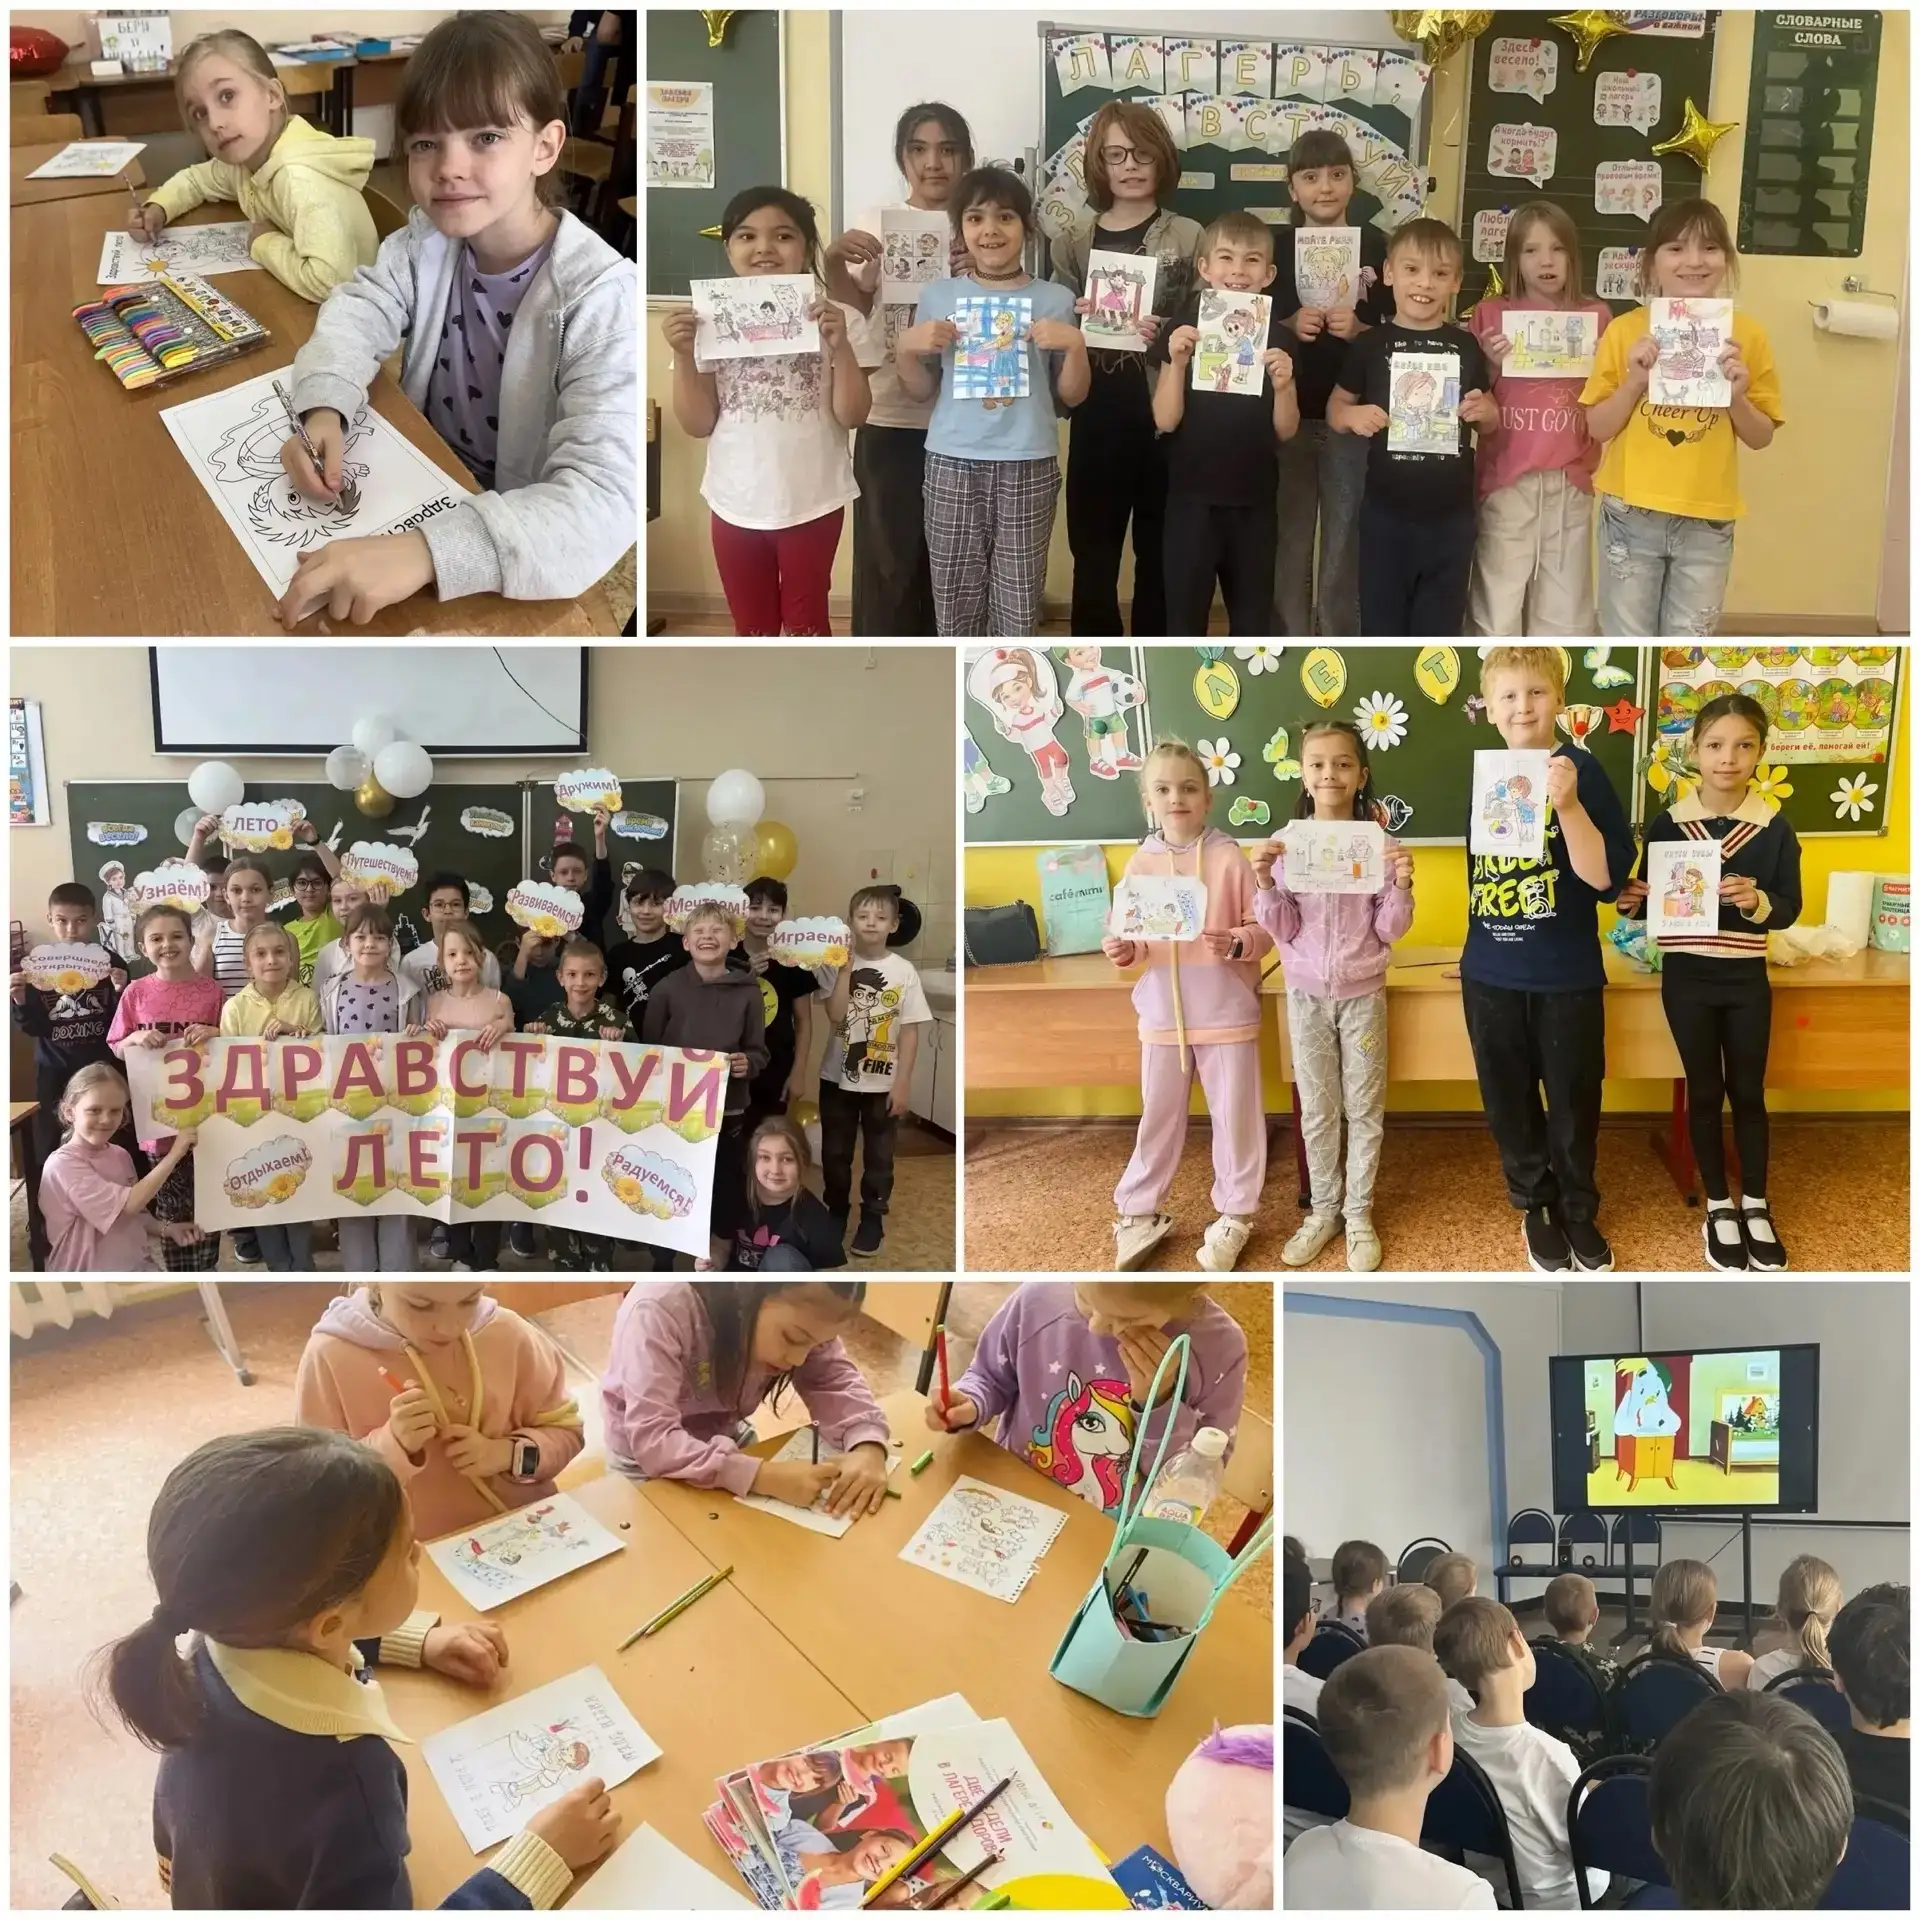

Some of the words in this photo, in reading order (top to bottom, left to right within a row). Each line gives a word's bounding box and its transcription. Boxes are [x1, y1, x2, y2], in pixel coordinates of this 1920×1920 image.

[1775, 14, 1863, 29] СЛОВАРНЫЕ
[1501, 40, 1534, 53] Здесь
[1794, 32, 1842, 45] СЛОВА
[1494, 55, 1540, 66] весело!
[1479, 211, 1510, 224] Любл
[1480, 227, 1507, 238] лаге
[1502, 406, 1539, 431] UST
[380, 496, 457, 536] Здравс
[1770, 742, 1800, 751] береги
[1819, 741, 1853, 750] помогай
[1856, 741, 1870, 750] ей!
[559, 779, 617, 797] Дружим!
[232, 817, 279, 832] ЛЕТО
[347, 852, 418, 882] Путешествуем!
[135, 879, 209, 901] Узнаём!
[512, 889, 582, 925] Развиваемся!
[773, 931, 852, 946] Играем!
[29, 954, 110, 967] Совершаем
[33, 964, 104, 973] открытия!
[51, 1022, 105, 1042] BOXING
[863, 1059, 893, 1076] FIRE
[163, 1040, 720, 1129] ЗДРАВСТВУЙ
[230, 1148, 311, 1191] Отдыхаем!
[336, 1126, 593, 1203] ЛЕТО!
[613, 1153, 694, 1211] Радуемся!
[942, 1772, 973, 1810] ЛАГЕРЕ
[970, 1818, 1006, 1863] ДОРОВЯ
[963, 1775, 986, 1797] ДВЕ
[983, 1804, 1012, 1843] ЕДЕЛИ
